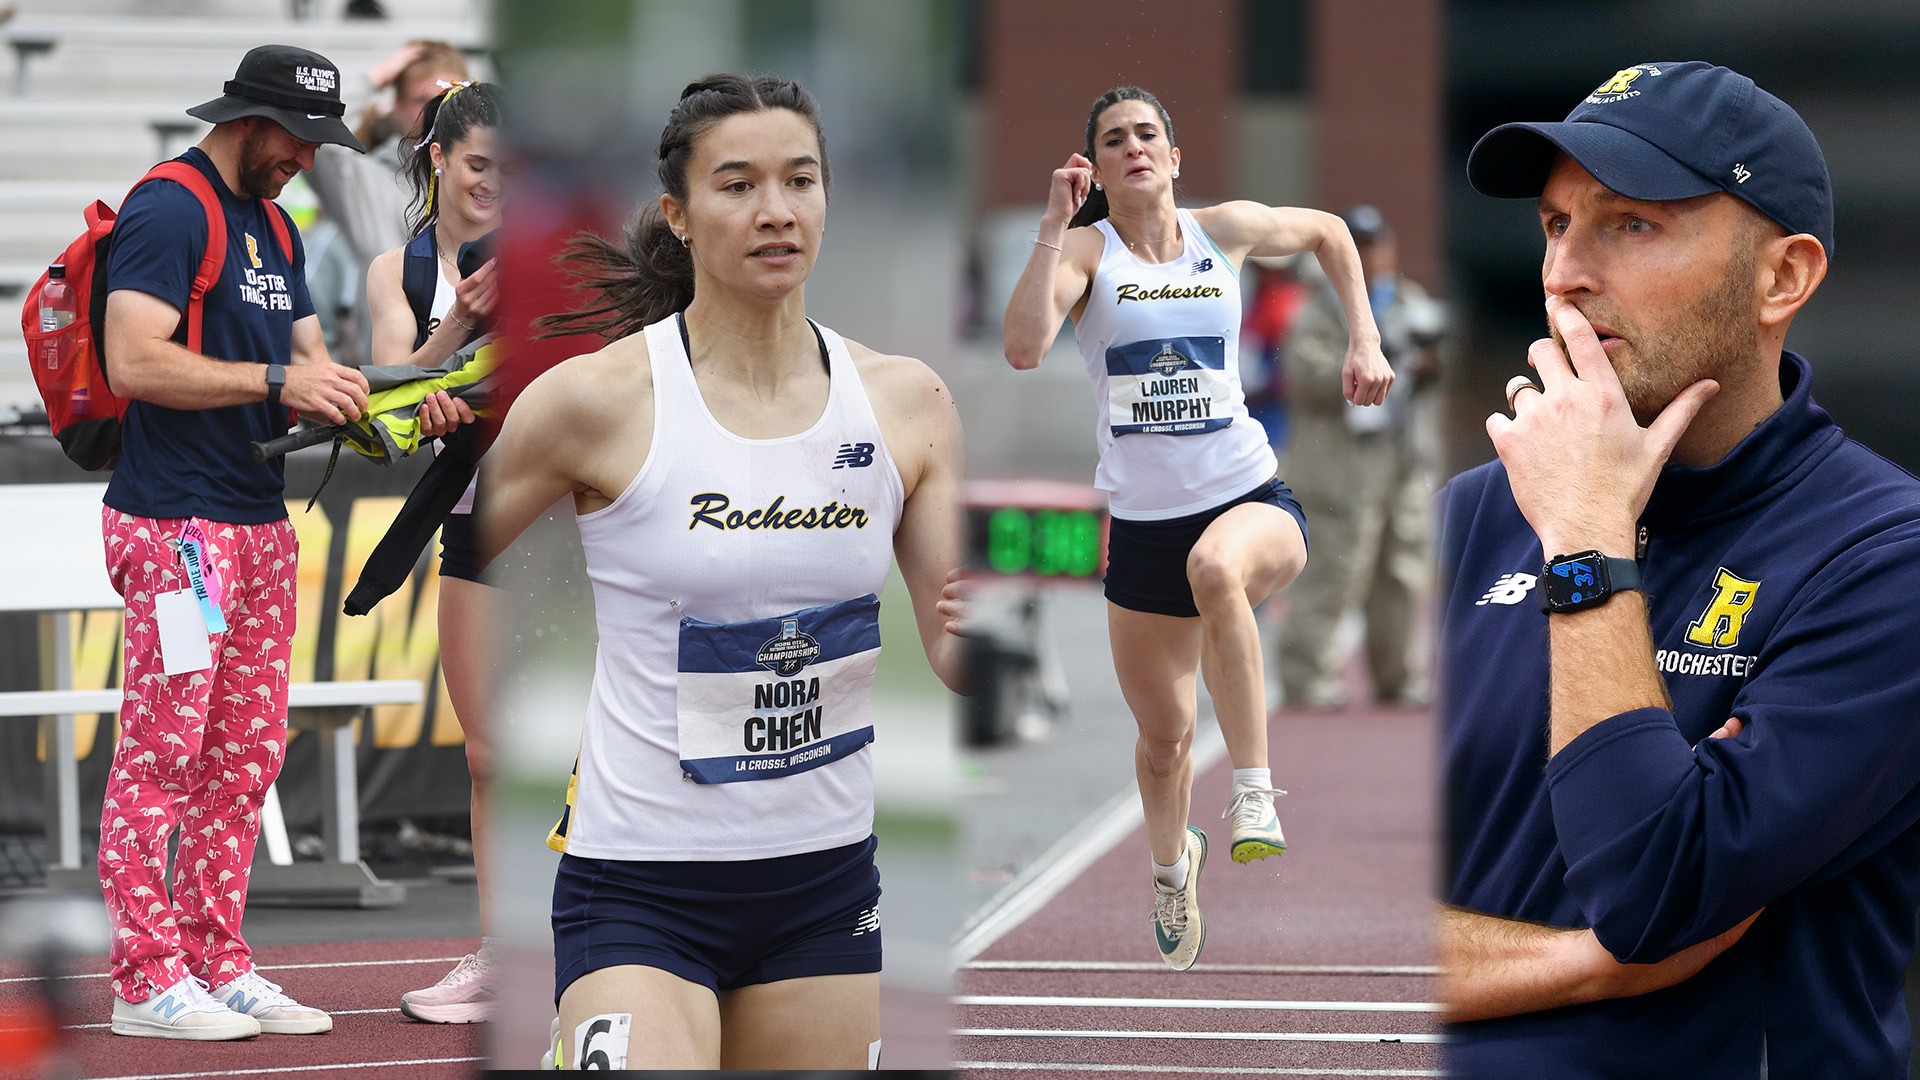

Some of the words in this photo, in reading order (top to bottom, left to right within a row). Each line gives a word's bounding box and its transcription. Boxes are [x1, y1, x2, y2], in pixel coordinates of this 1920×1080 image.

[295, 74, 315, 86] TEAM
[296, 66, 310, 77] U.S.
[1116, 283, 1223, 305] Rochester
[1141, 377, 1199, 397] LAUREN
[1132, 397, 1212, 423] MURPHY
[1174, 422, 1206, 431] WISCONSIN
[688, 492, 869, 531] Rochester
[183, 542, 200, 568] JUMP
[191, 568, 209, 601] TRIPLE
[758, 645, 819, 662] CHAMPIONSHIPS
[1655, 649, 1758, 678] ROCHESTER
[754, 677, 820, 709] NORA
[744, 706, 823, 752] CHEN
[735, 760, 746, 772] LA
[748, 758, 788, 771] CROSSE,
[789, 744, 832, 766] WISCONSIN
